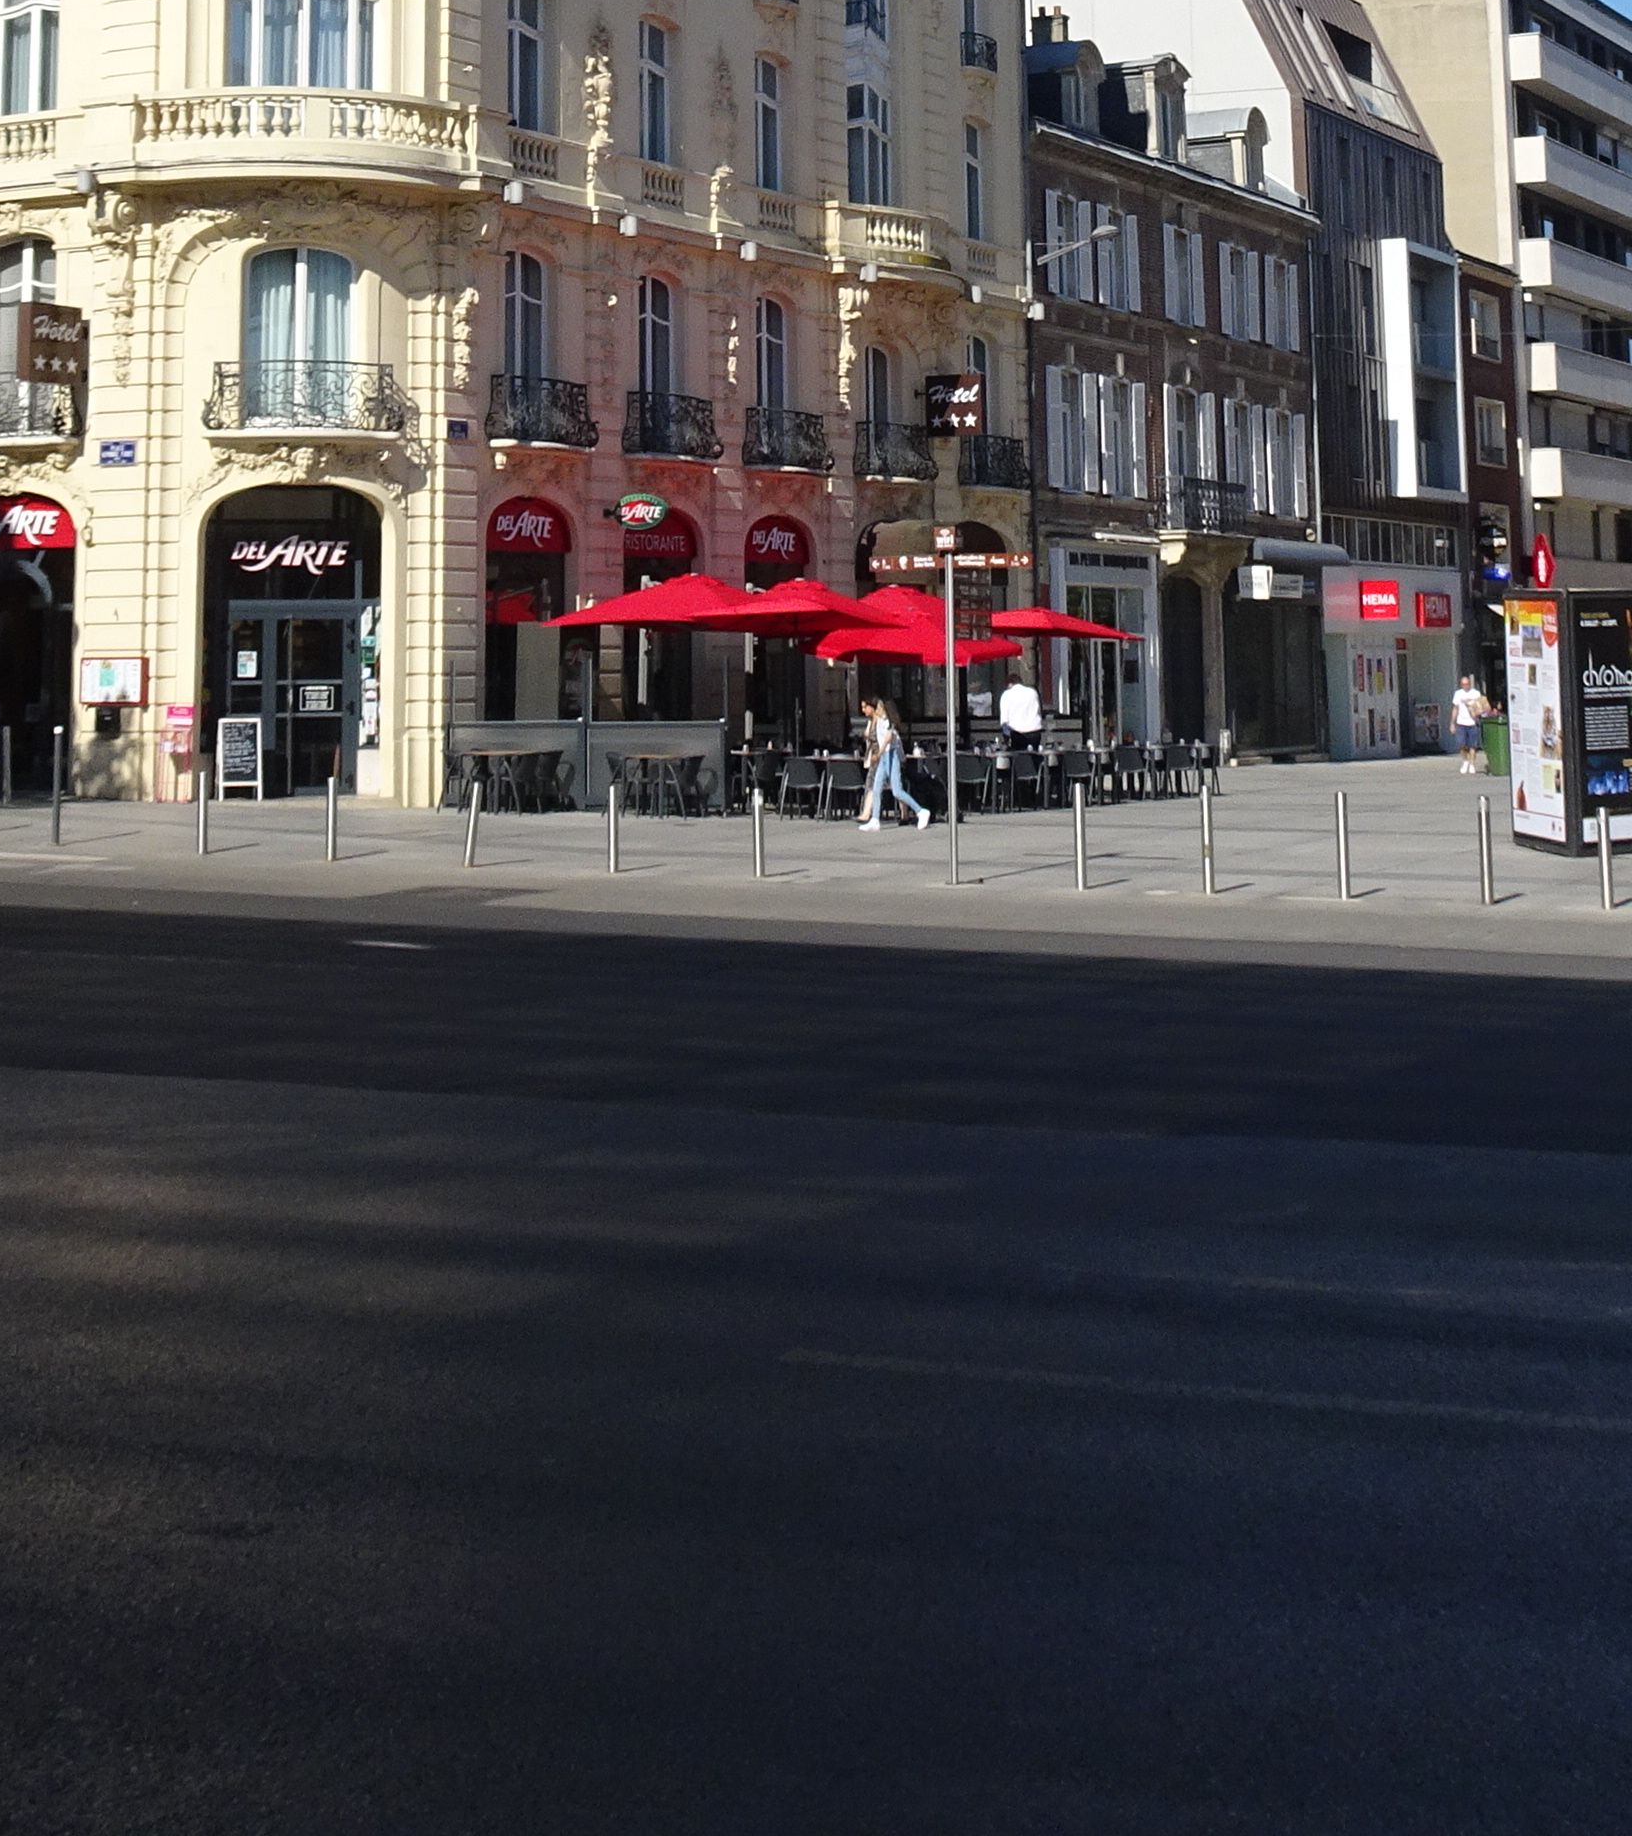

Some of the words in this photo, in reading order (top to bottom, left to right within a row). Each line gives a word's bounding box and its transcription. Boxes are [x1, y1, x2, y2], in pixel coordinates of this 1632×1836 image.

[32, 315, 82, 343] Hôtel
[928, 383, 980, 405] Hôtel
[496, 515, 515, 532] DEL
[622, 503, 663, 524] ARTE
[502, 509, 554, 548] ARTE
[231, 540, 267, 560] DEL
[624, 533, 687, 552] RISTORANTE
[756, 526, 796, 560] ARTE
[240, 534, 351, 576] ARTE
[1362, 593, 1397, 606] HEMA
